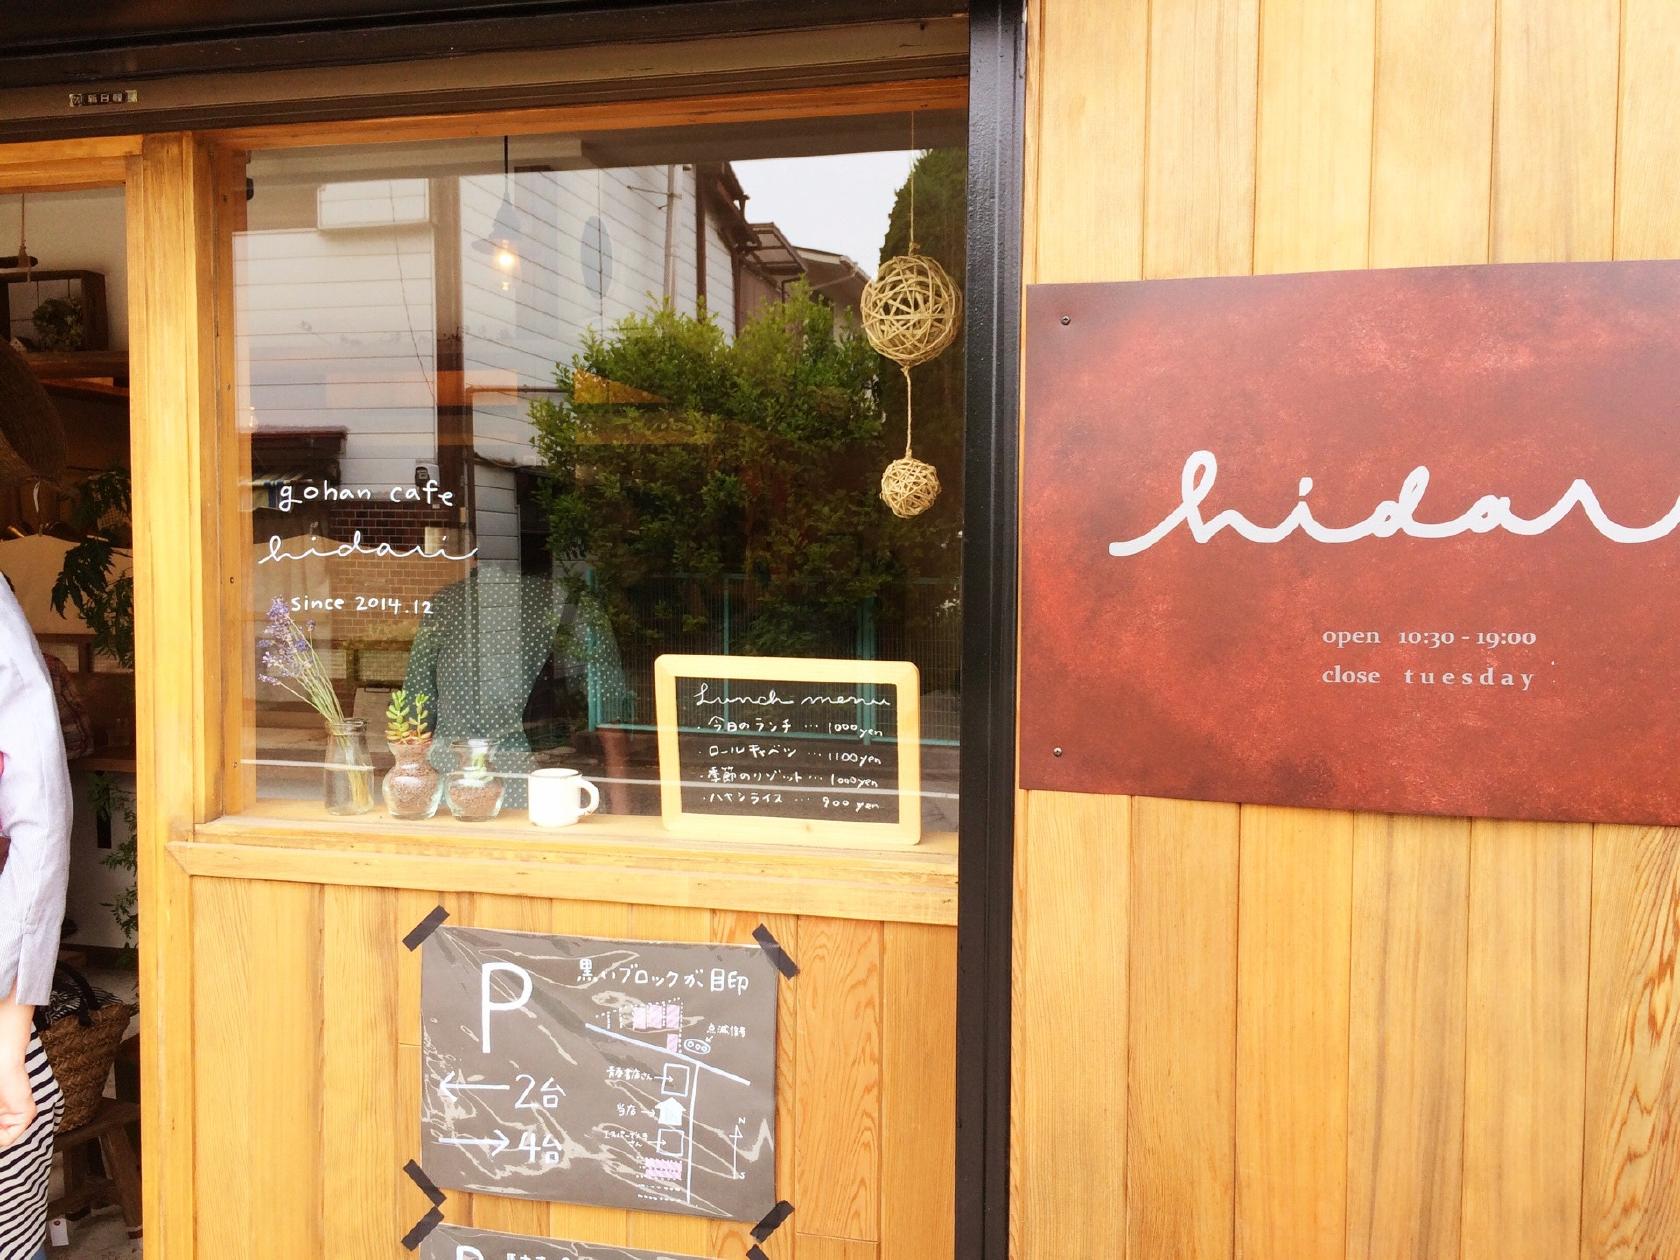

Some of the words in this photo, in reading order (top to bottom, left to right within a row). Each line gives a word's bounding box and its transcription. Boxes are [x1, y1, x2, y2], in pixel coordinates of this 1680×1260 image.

[278, 480, 371, 512] gohan
[389, 479, 454, 507] cafe
[257, 530, 479, 564] hidari
[290, 595, 345, 611] since
[355, 596, 434, 615] 2014.12
[1322, 630, 1381, 648] open
[1399, 631, 1455, 648] 10:30
[1476, 631, 1537, 649] 19:00
[1322, 665, 1381, 684] close
[1404, 667, 1535, 691] tuesday
[693, 682, 795, 706] Lunch
[800, 695, 891, 706] menu
[708, 715, 792, 734] 今日のランチ
[481, 961, 533, 1054] P
[514, 1073, 567, 1110] 2台
[518, 1131, 563, 1165] 4台
